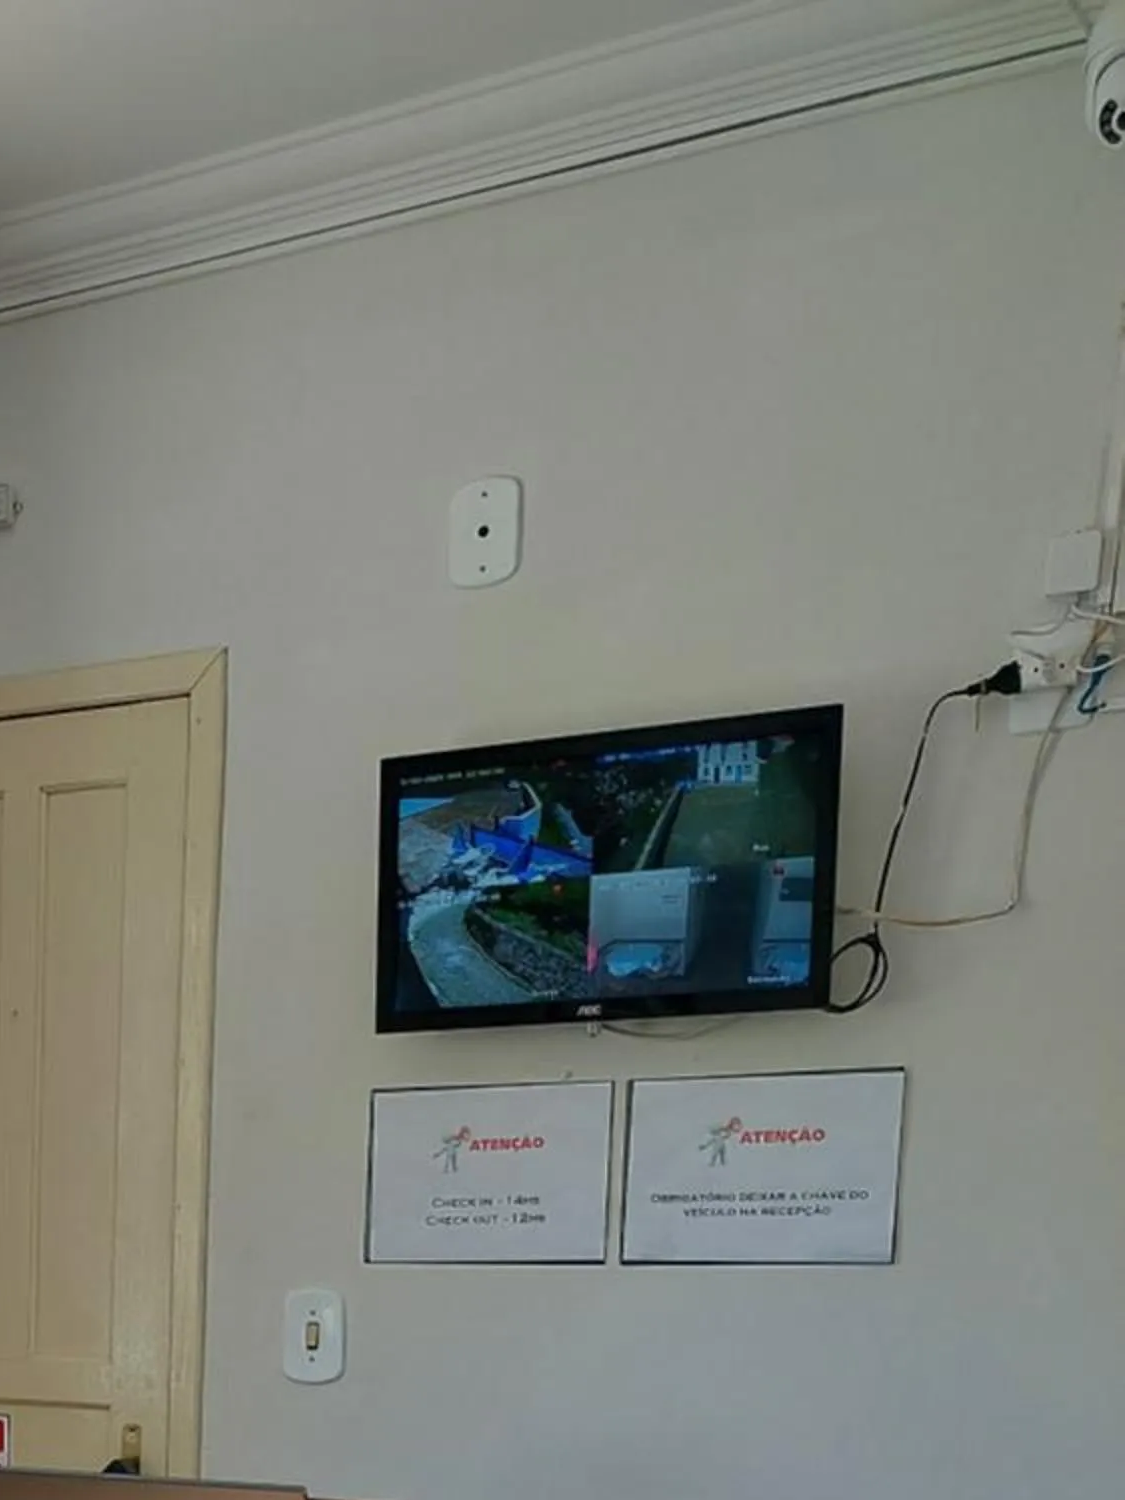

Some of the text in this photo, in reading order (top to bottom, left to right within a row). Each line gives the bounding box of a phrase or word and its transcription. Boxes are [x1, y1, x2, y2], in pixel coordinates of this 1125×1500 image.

[469, 1134, 545, 1152] ATENÇÃO
[738, 1126, 826, 1145] ATENÇÃO
[848, 1189, 870, 1201] DO
